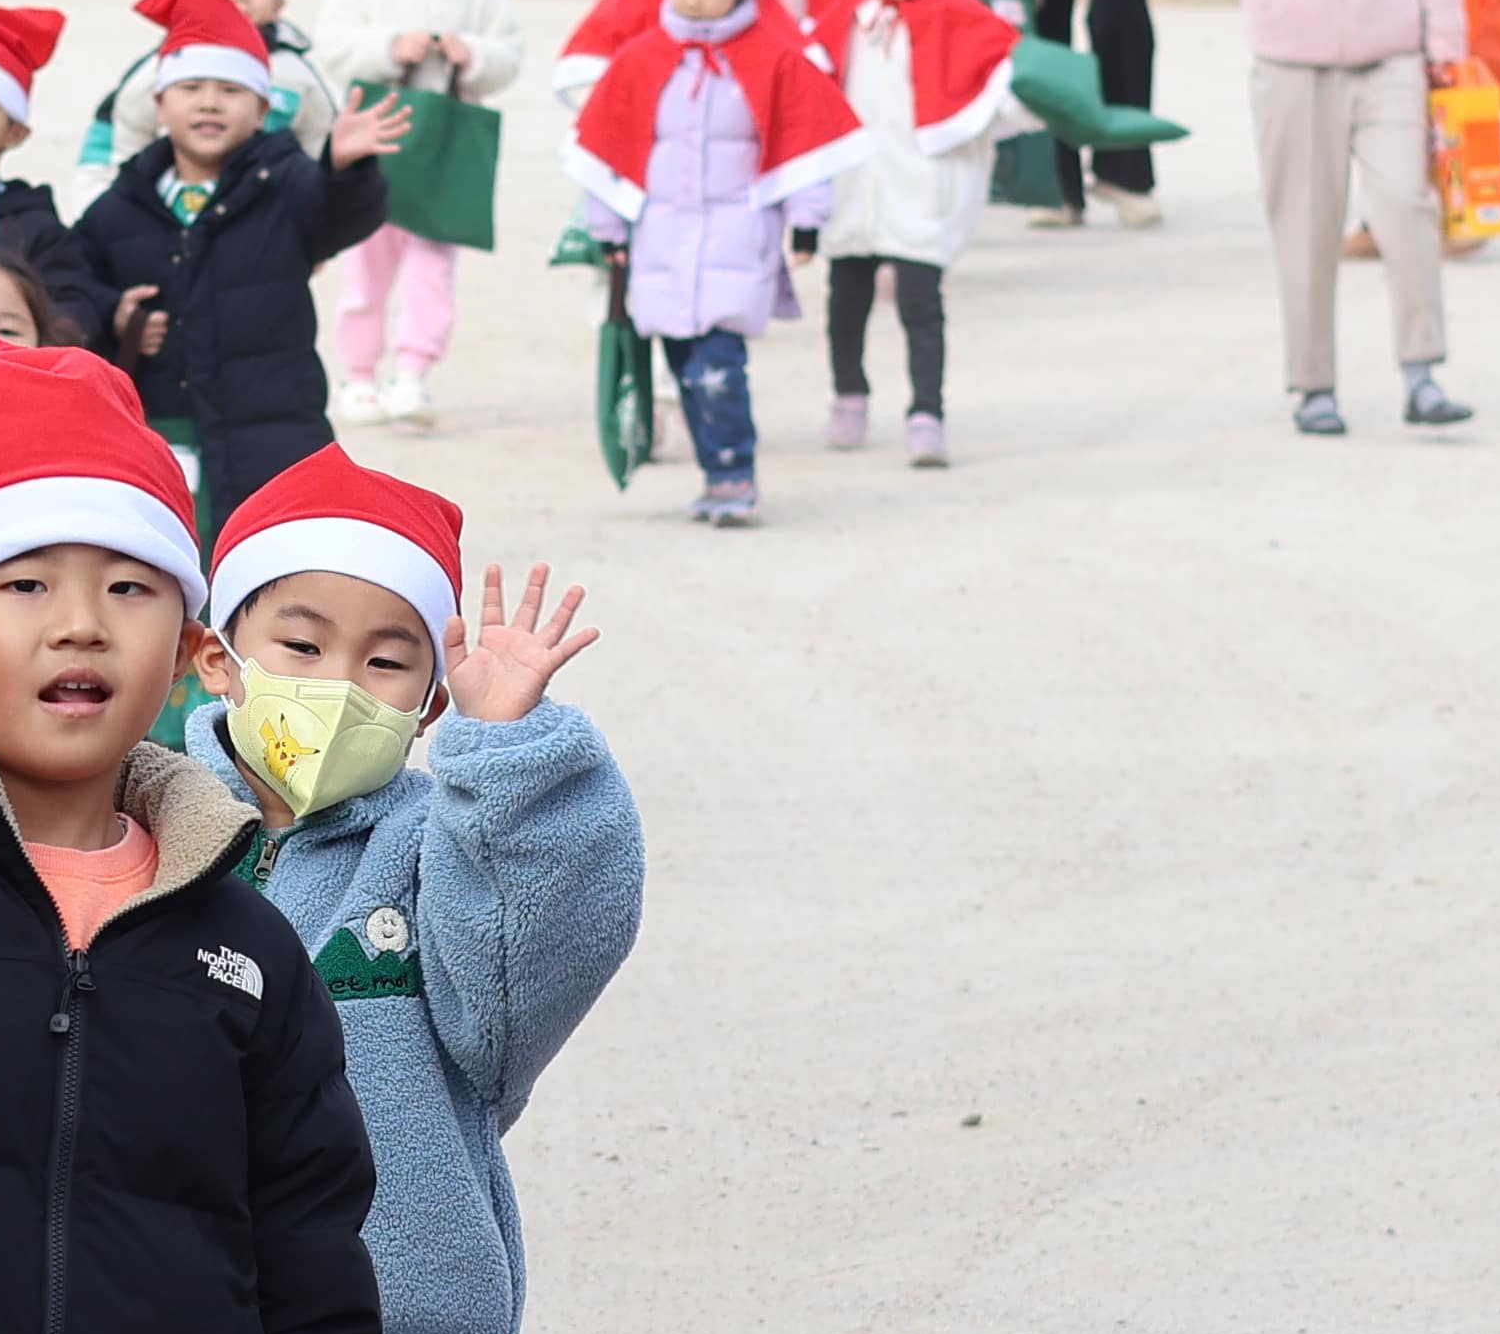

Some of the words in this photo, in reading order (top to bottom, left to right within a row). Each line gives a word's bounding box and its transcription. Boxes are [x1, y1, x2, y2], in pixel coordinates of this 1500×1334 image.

[197, 948, 244, 977] NORTH
[219, 945, 246, 967] THE
[207, 965, 243, 988] FACE
